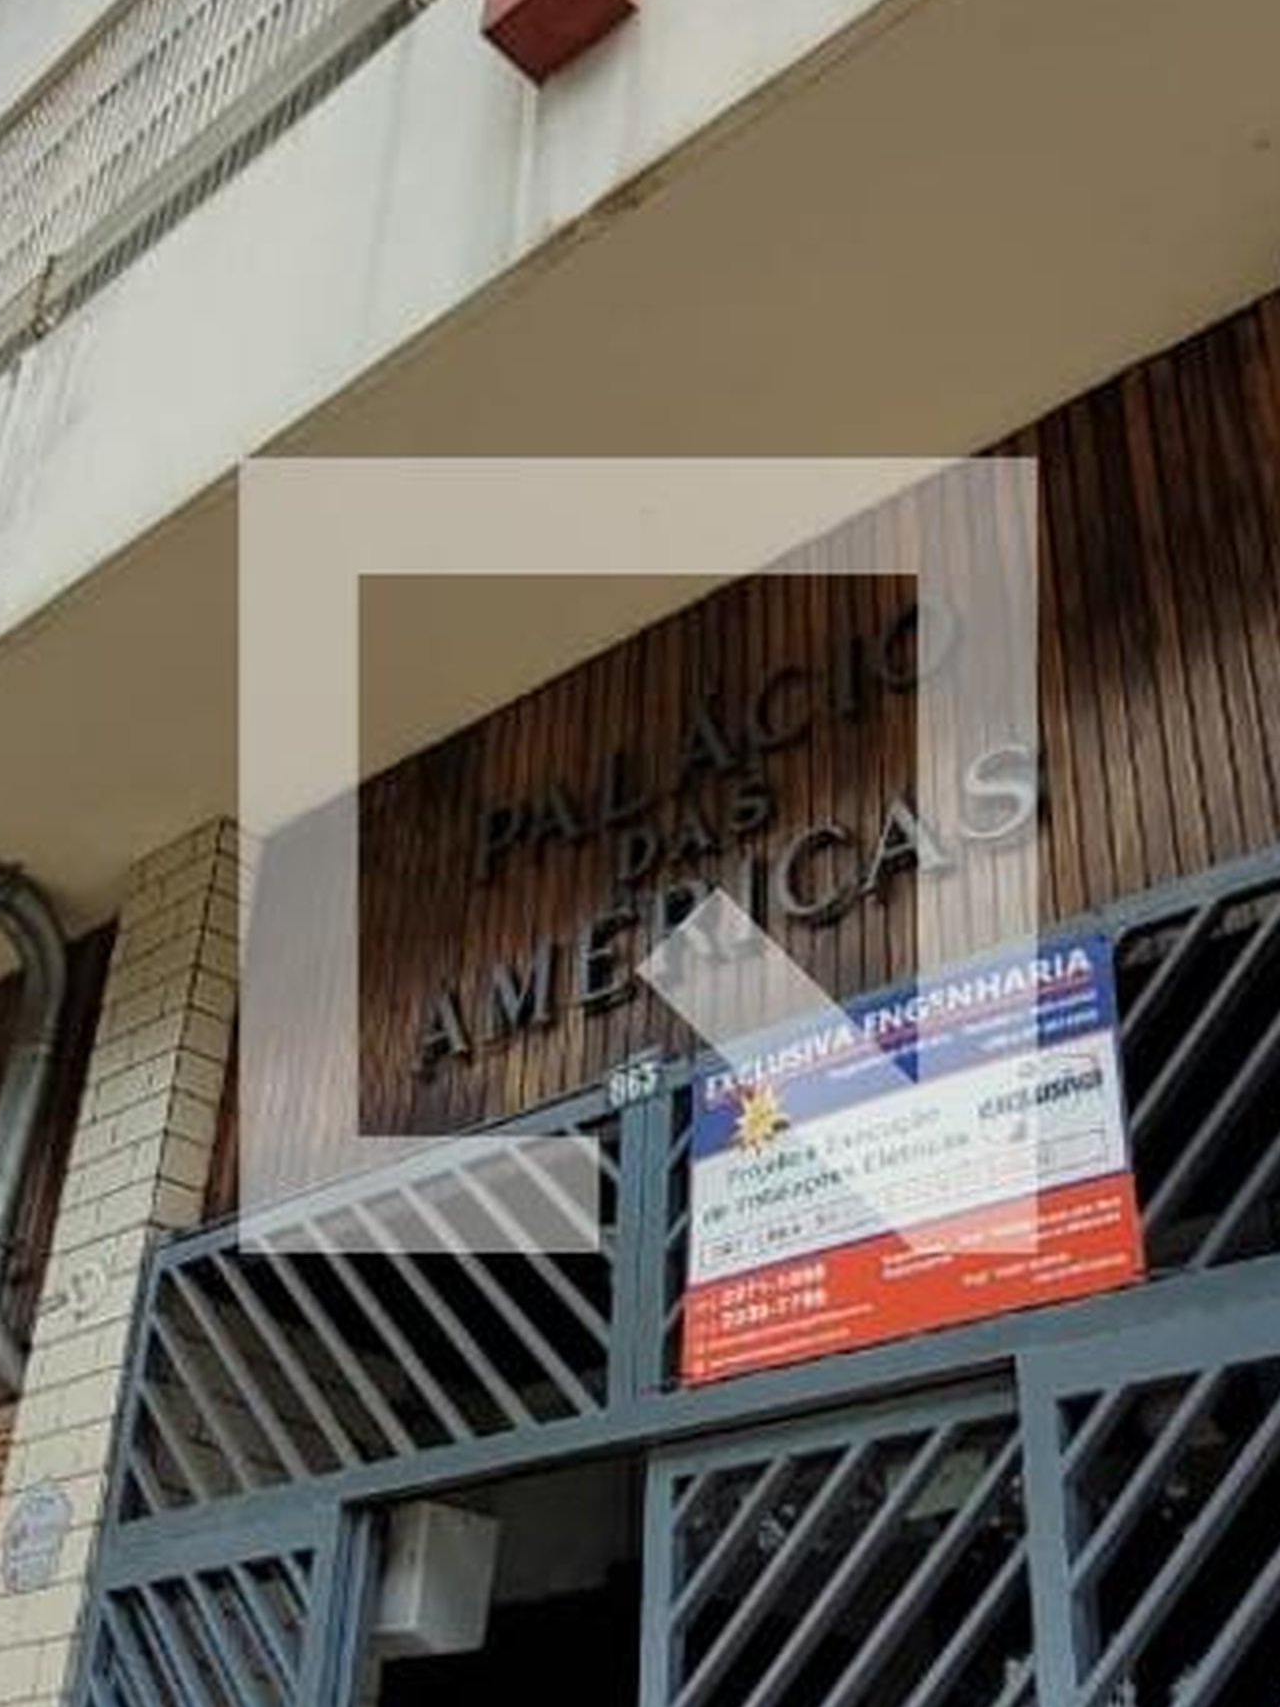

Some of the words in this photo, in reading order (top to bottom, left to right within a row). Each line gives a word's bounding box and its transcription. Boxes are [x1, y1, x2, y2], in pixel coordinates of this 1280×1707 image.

[620, 782, 774, 882] DAS
[705, 1024, 856, 1101] EXCLUSIVA
[862, 947, 1093, 1038] ENGENHARIA
